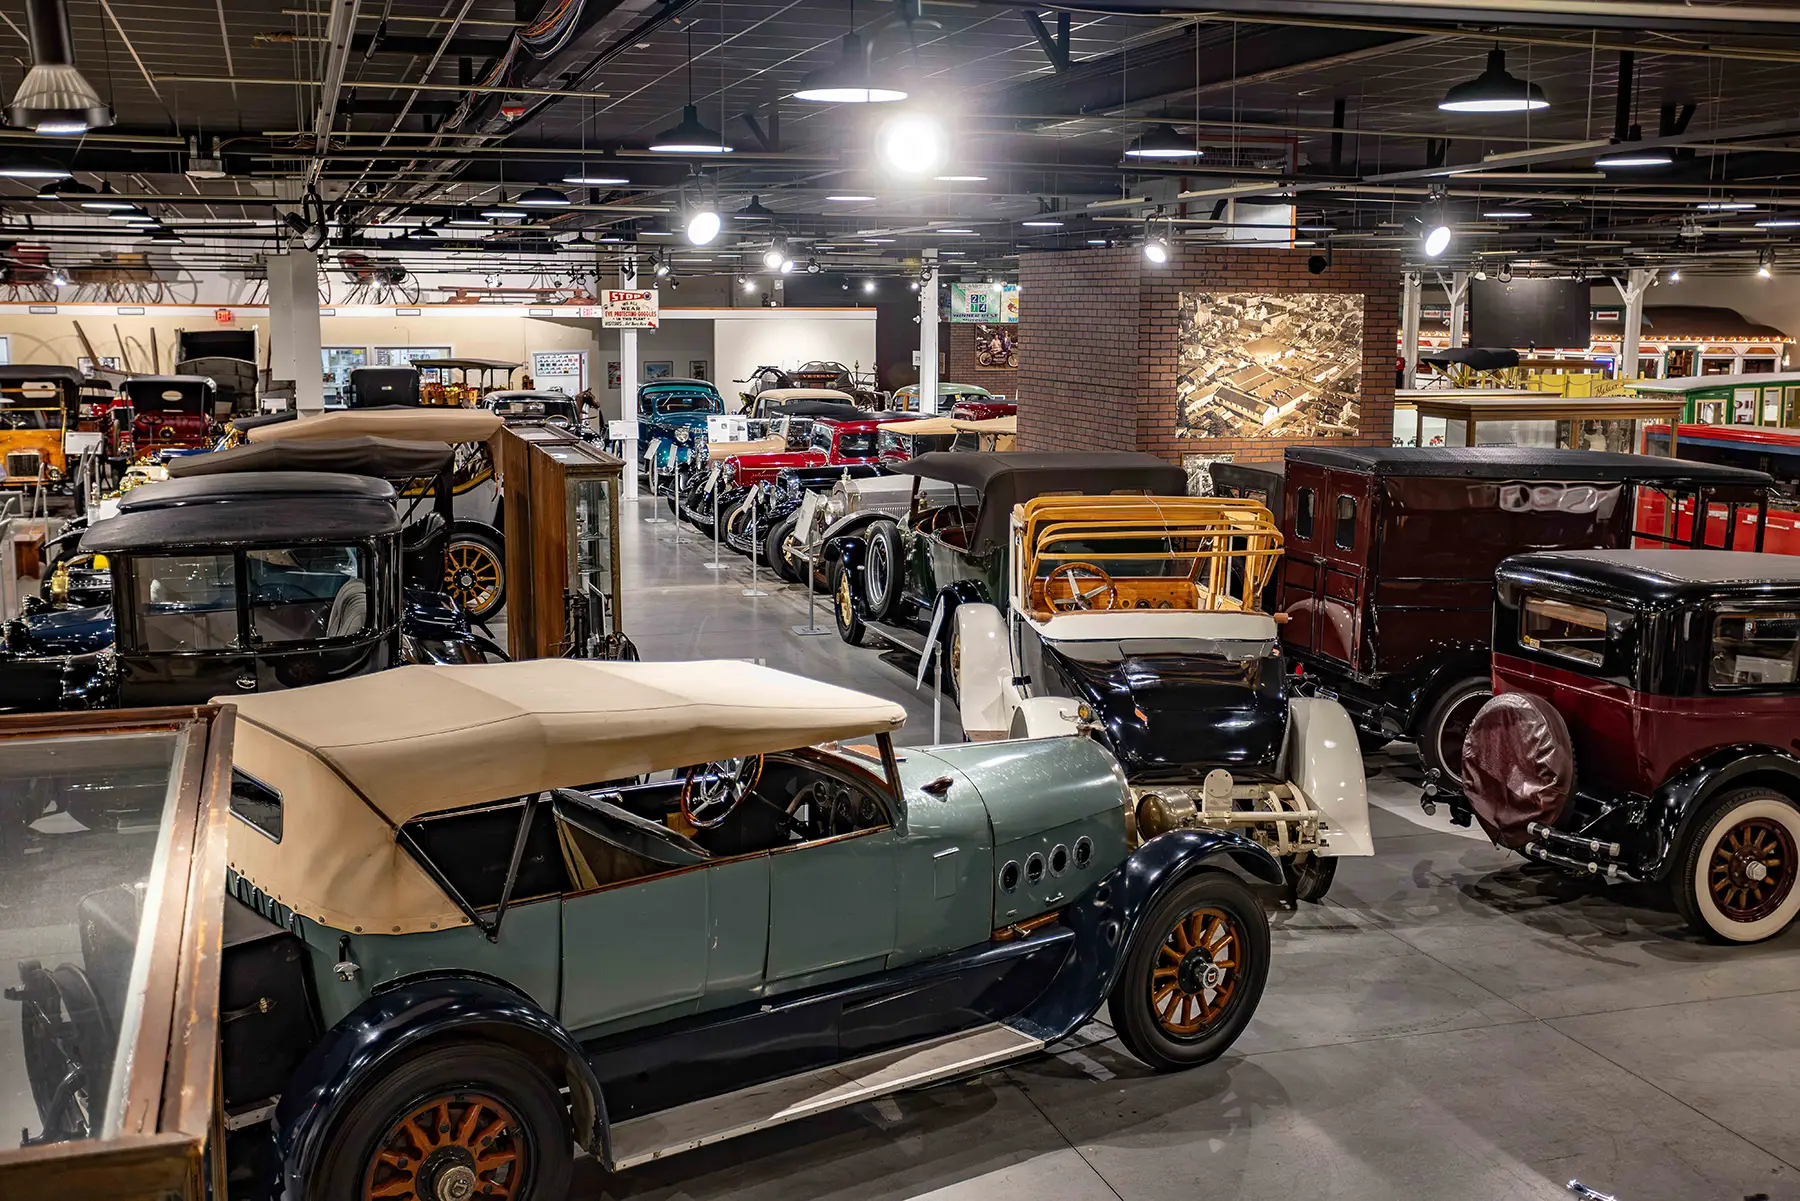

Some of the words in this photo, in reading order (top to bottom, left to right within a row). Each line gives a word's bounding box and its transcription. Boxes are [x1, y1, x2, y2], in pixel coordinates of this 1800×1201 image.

[611, 291, 641, 301] STOP
[971, 294, 986, 303] 20
[972, 304, 986, 312] 14
